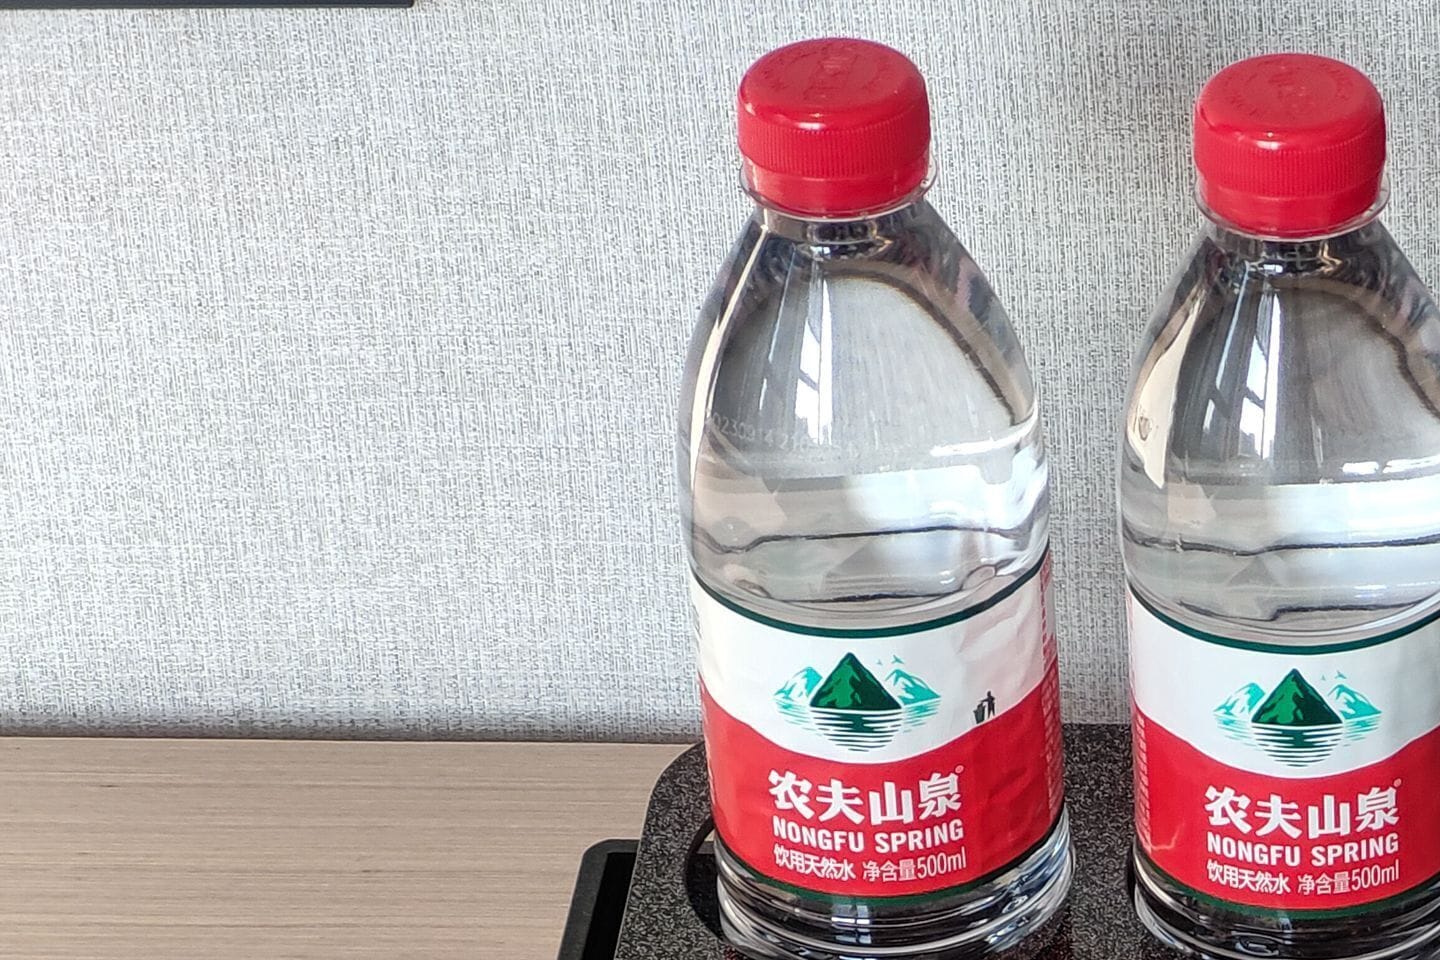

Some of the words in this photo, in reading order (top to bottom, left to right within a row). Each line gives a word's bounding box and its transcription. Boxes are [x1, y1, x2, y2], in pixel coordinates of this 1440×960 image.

[768, 769, 962, 826] 农夫山泉
[1204, 785, 1400, 840] 农夫山泉
[772, 815, 865, 853] NONGFU
[873, 818, 965, 854] SPRING
[1206, 831, 1300, 867] NONGFU
[1311, 832, 1399, 867] SPRING
[773, 843, 856, 881] 饮用天然水
[863, 846, 967, 882] 净含量500ml
[1206, 859, 1291, 895] 饮用天然水
[1298, 858, 1400, 895] 净含量500ml
